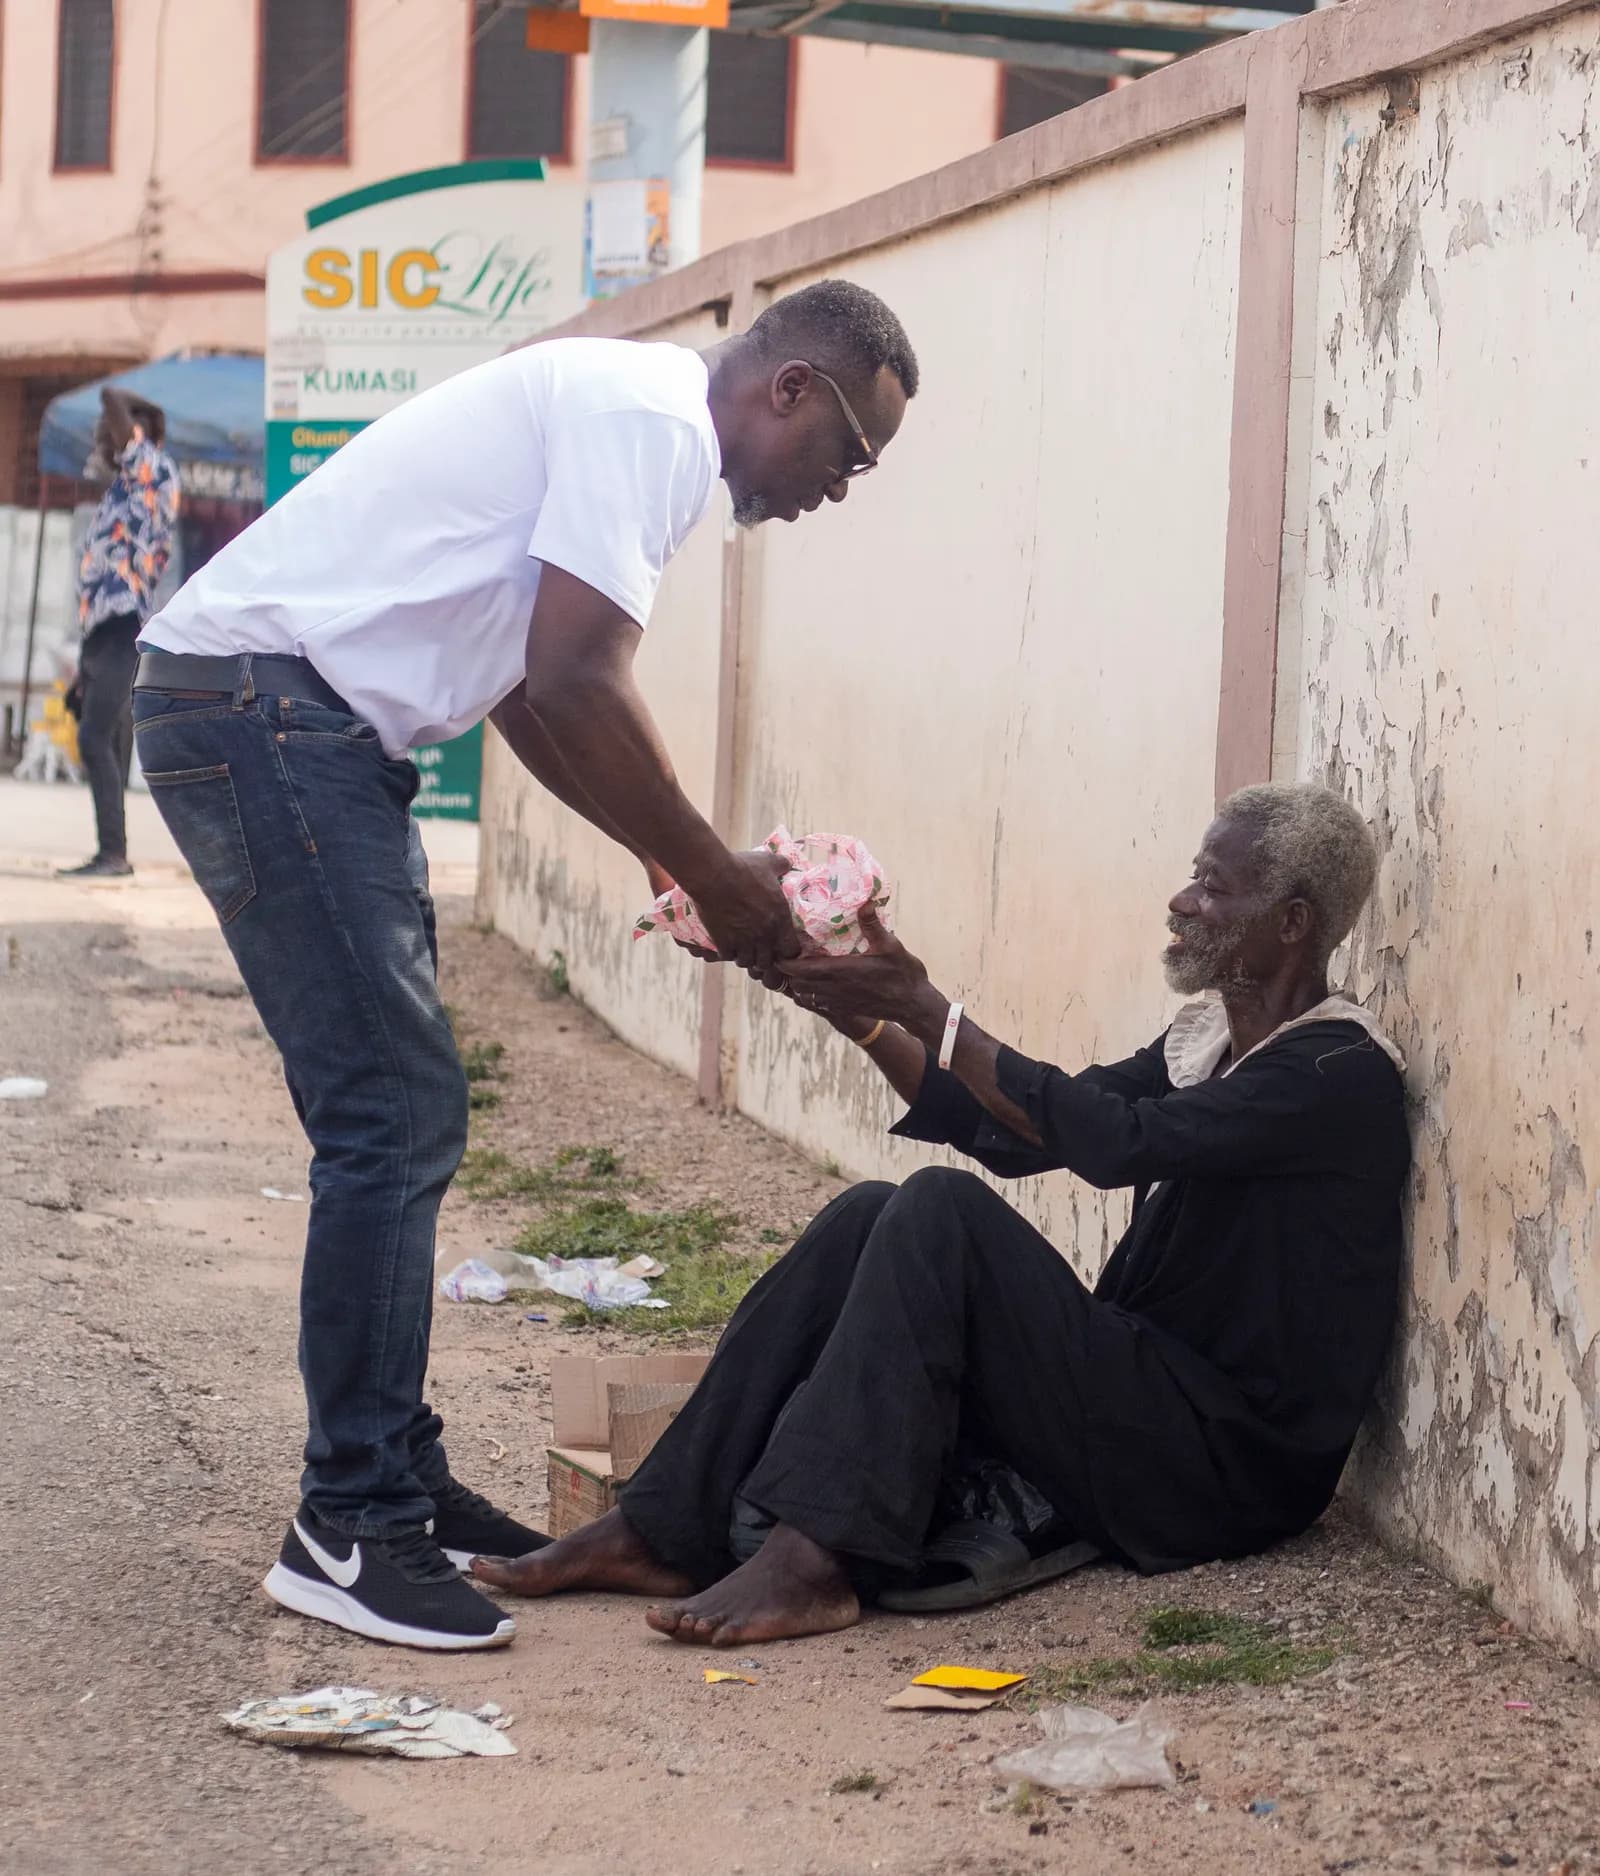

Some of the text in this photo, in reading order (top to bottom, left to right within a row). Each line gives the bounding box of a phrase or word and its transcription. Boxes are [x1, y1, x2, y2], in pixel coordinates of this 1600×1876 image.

[302, 229, 552, 330] SIC Life
[302, 368, 417, 394] KUMASI
